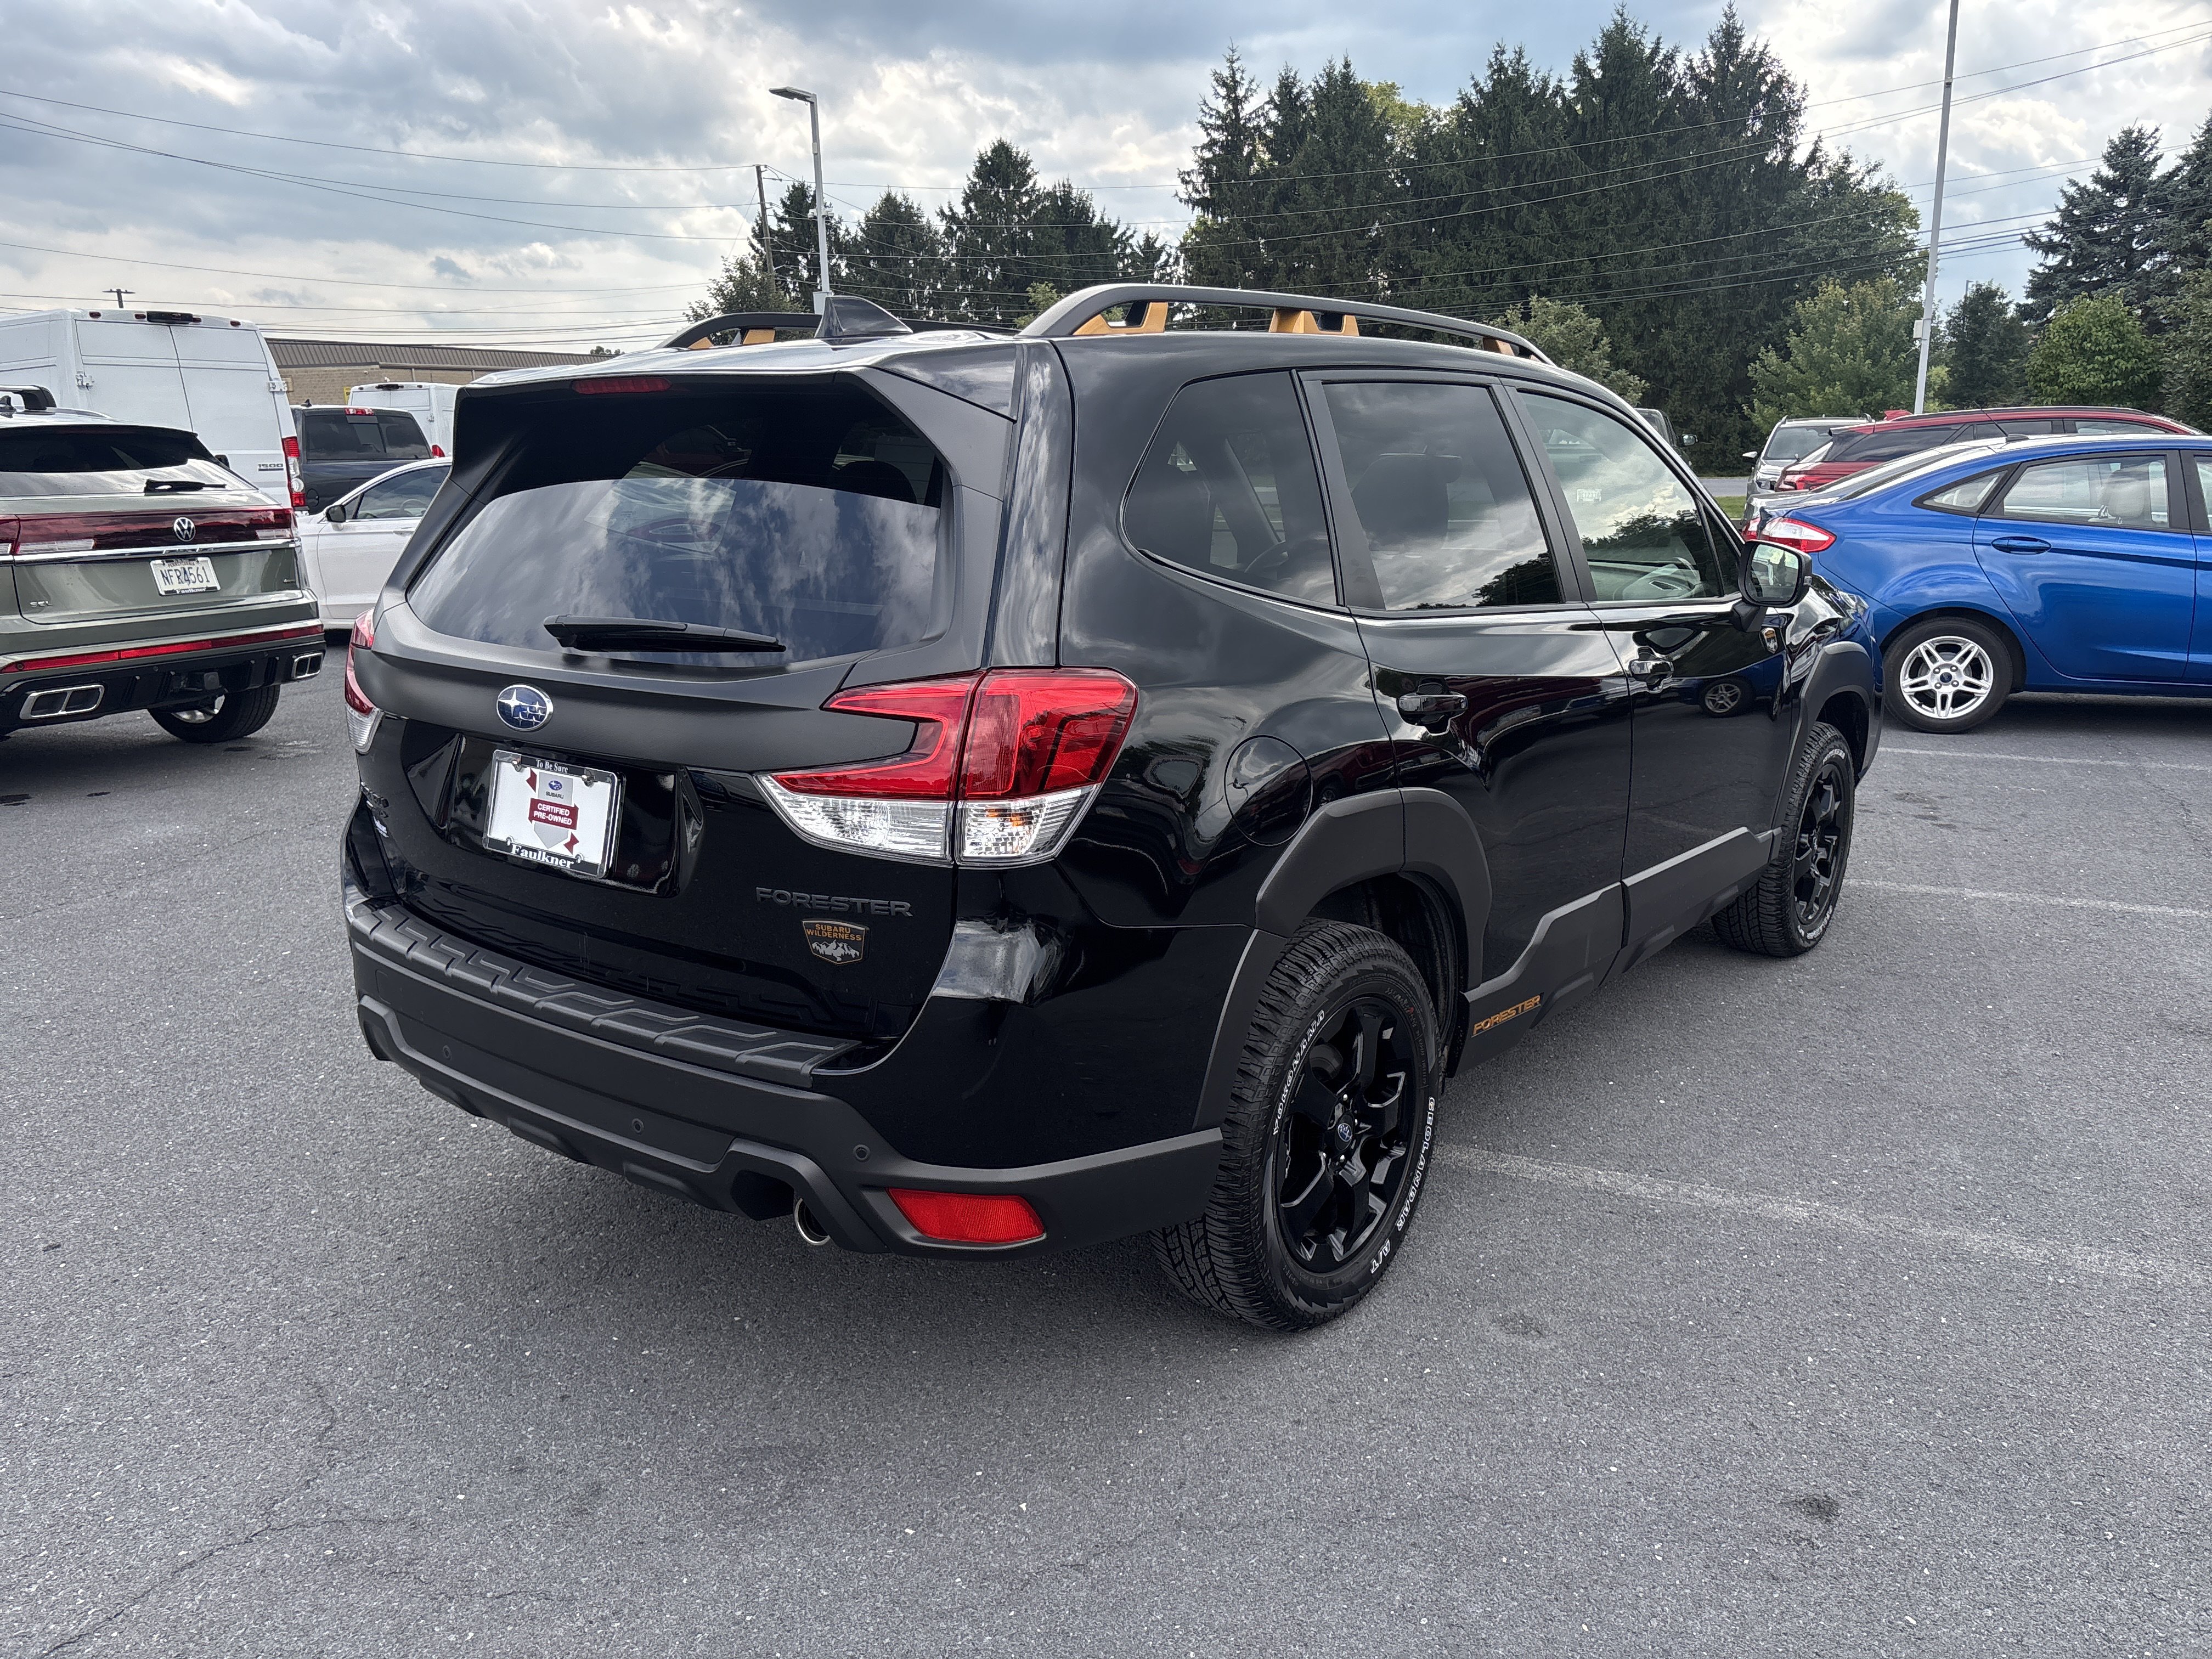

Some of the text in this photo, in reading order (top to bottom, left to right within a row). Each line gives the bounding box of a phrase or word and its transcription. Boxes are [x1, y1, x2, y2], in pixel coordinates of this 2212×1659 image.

[160, 566, 210, 585] NFR4561
[535, 759, 568, 773] To Be Sure
[533, 811, 572, 826] PRE-OWNED
[537, 803, 570, 816] CERTIFIED
[511, 844, 574, 868] Faulkner
[755, 887, 913, 917] FORESTER
[806, 928, 862, 941] WILDERNESS
[815, 923, 850, 934] SUBARU
[1473, 995, 1541, 1035] FORESTER
[1273, 1009, 1325, 1135] YOKOHAMA
[1371, 1097, 1435, 1273] GEOLANDAR A/T
